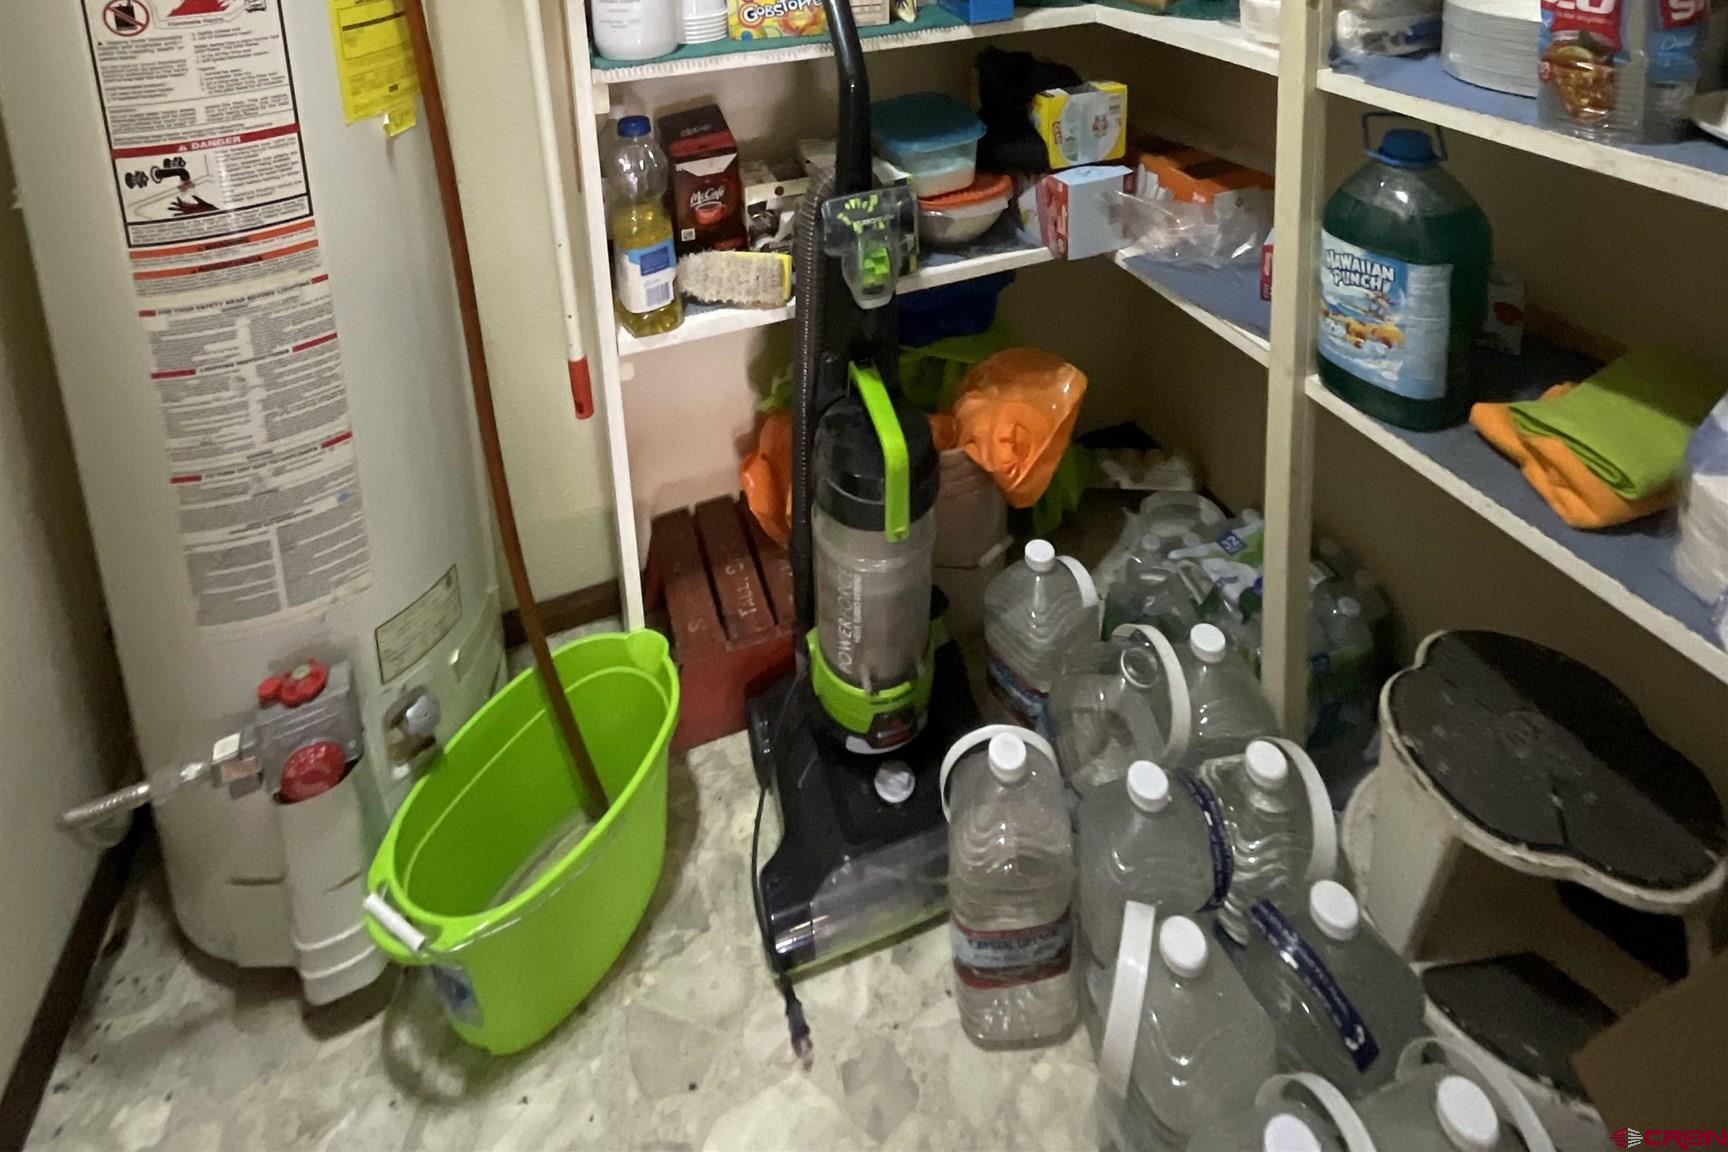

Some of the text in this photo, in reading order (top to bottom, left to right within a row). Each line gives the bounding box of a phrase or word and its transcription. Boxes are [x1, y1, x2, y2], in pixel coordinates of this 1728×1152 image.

[191, 136, 241, 149] DANGER
[1325, 249, 1396, 282] HAWAIIAN
[1332, 269, 1387, 292] PUNCH
